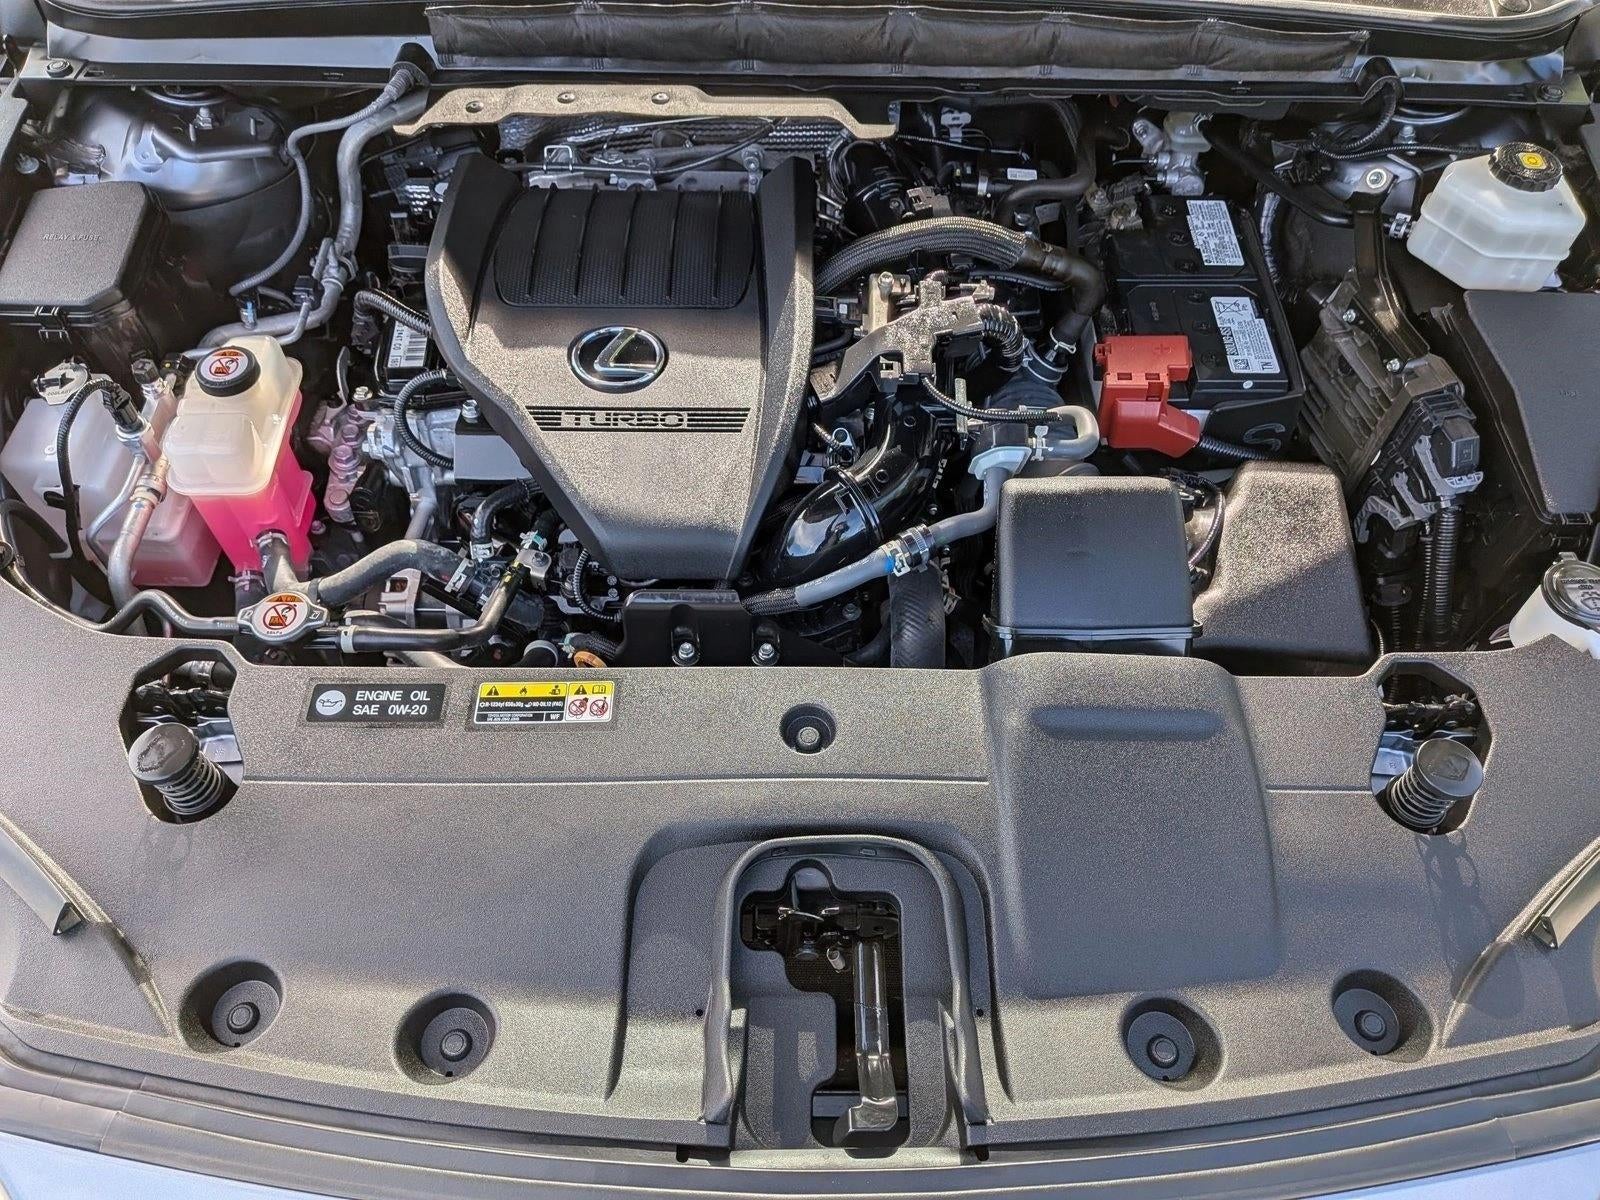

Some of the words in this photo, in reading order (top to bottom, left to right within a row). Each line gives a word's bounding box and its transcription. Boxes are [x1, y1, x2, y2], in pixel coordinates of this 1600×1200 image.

[562, 411, 686, 428] TURBO
[355, 690, 404, 701] ENGINE
[410, 690, 431, 701] OIL
[352, 704, 380, 716] SAE
[387, 704, 428, 716] 0W-20
